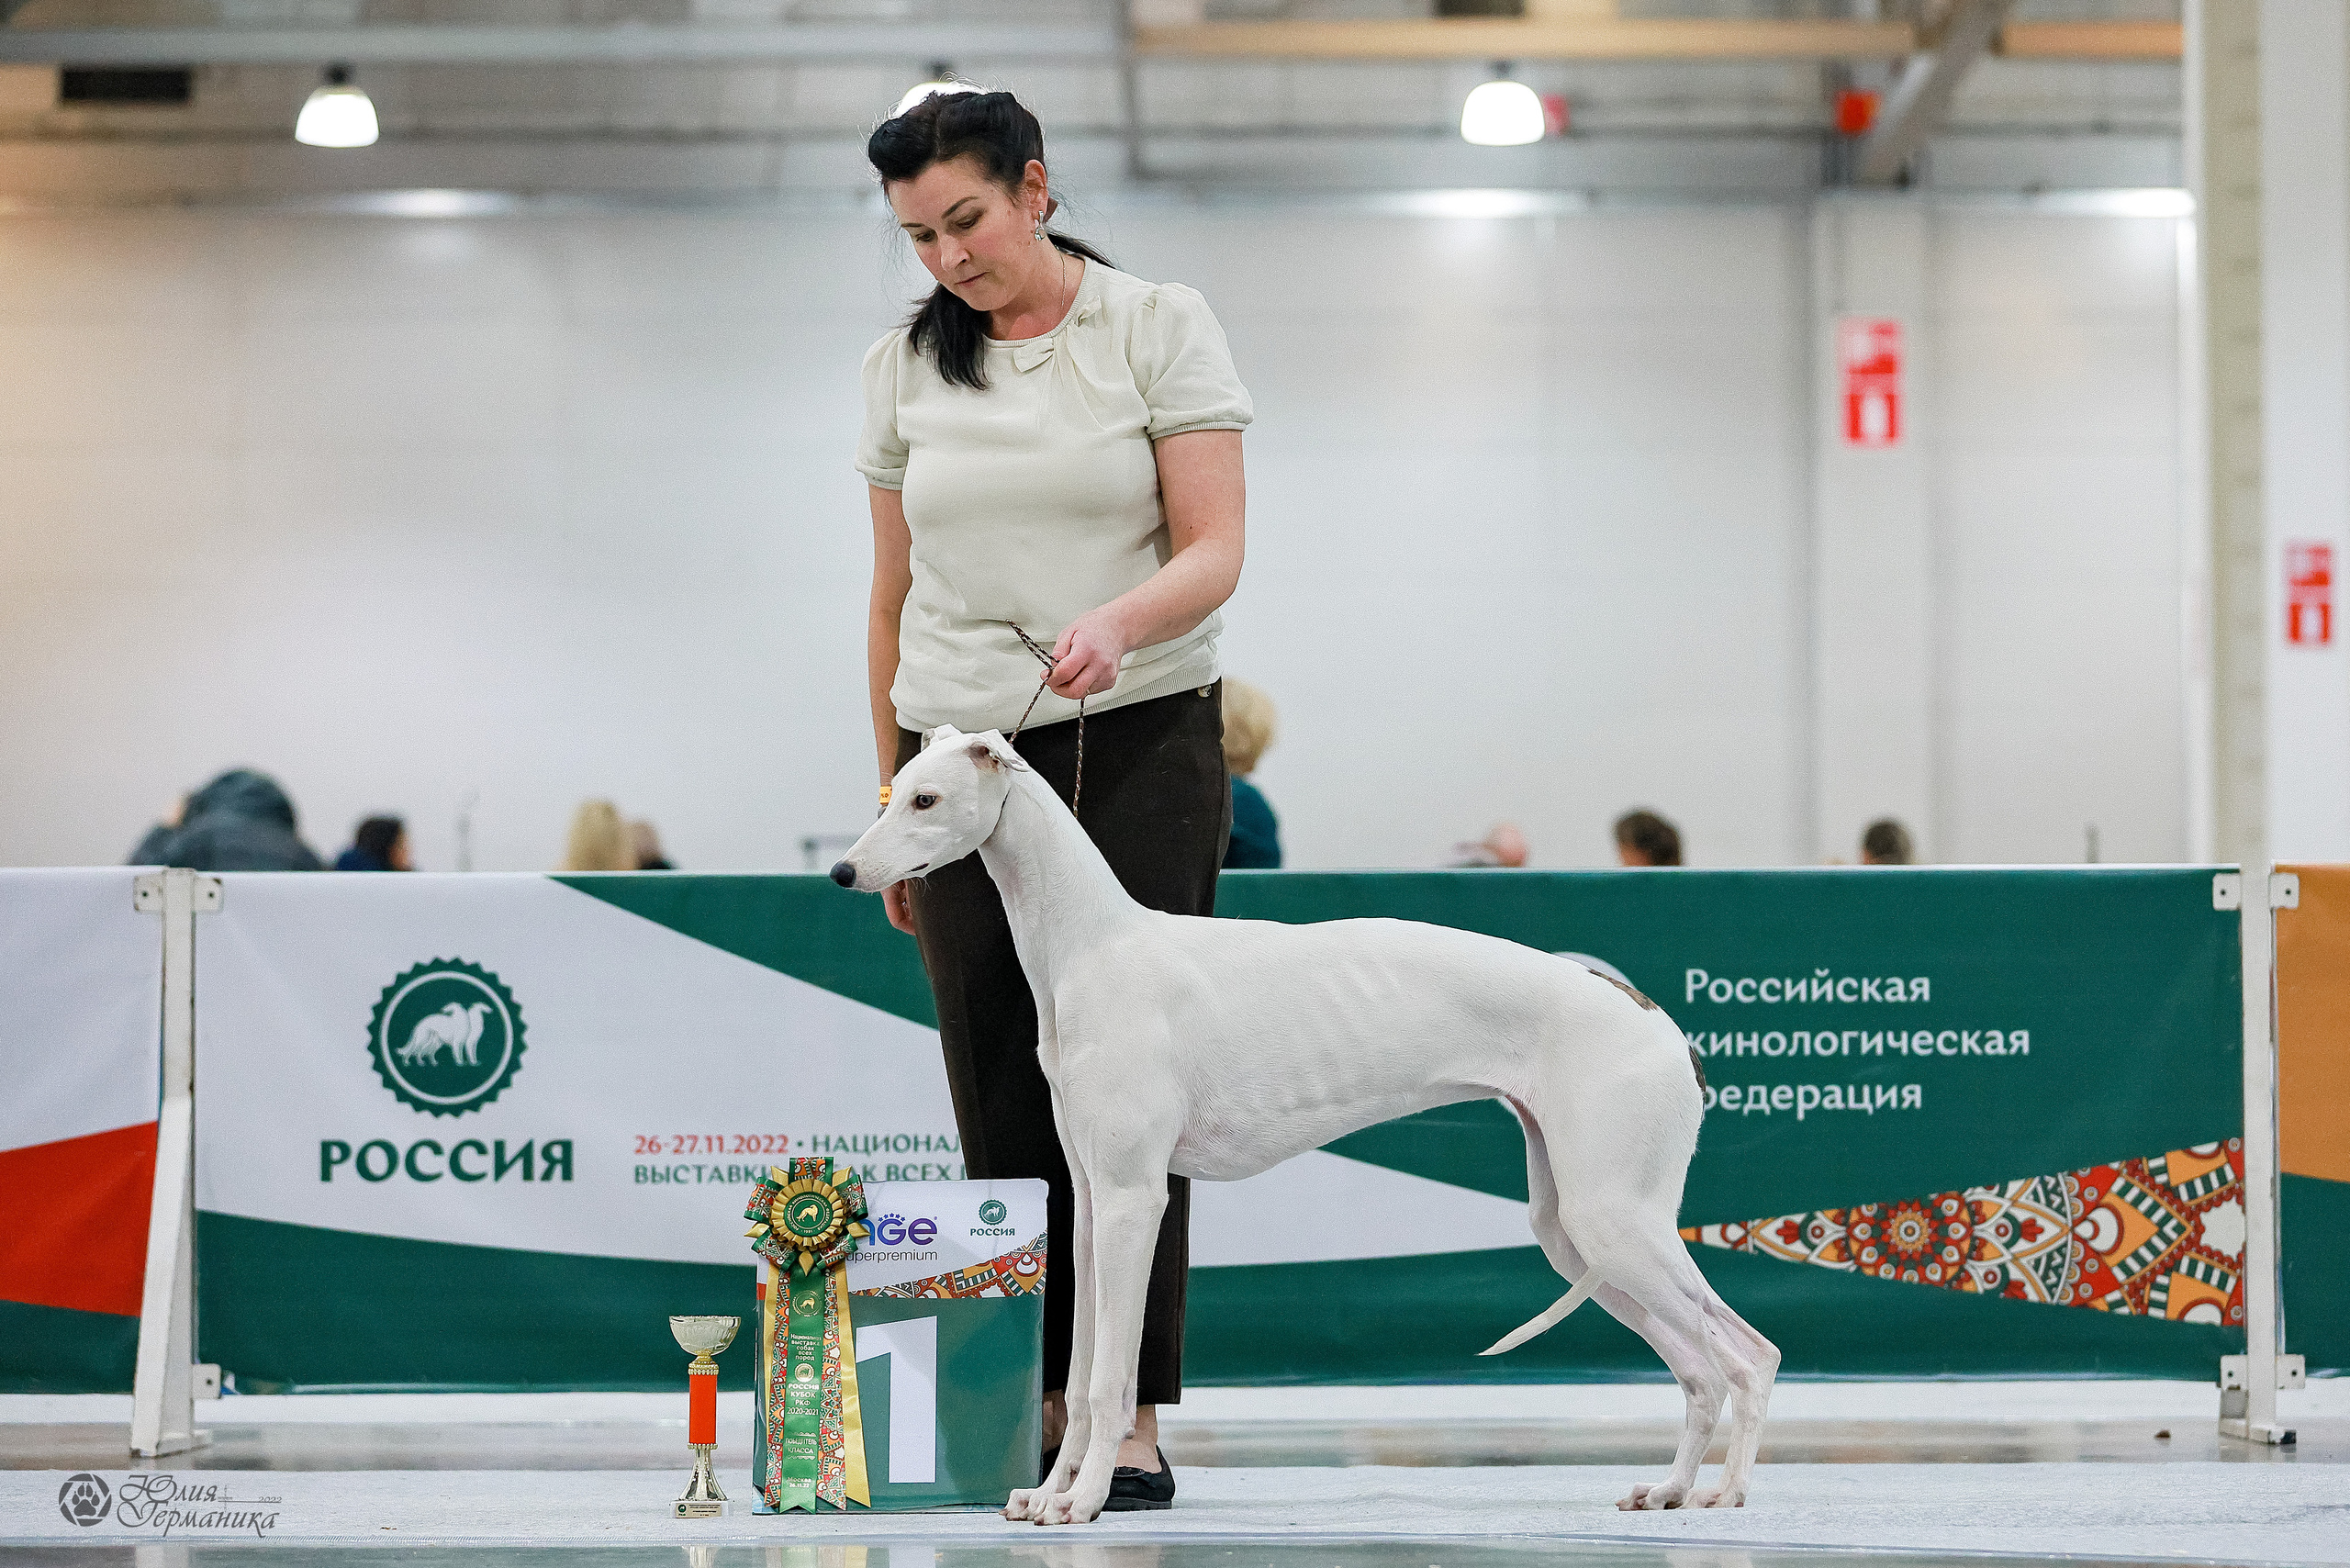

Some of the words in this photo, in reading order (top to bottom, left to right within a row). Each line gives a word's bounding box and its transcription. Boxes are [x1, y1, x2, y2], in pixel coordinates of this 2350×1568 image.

[1685, 968, 1930, 1002] Российская
[1685, 1029, 2030, 1057] кинологическая
[634, 1134, 789, 1155] 26-27.11.2022
[320, 1139, 574, 1182] РОССИЯ
[886, 1163, 952, 1182] ВСЕХ
[970, 1228, 1015, 1237] РОССИЯ
[846, 1249, 937, 1263] uperpremium
[856, 1316, 937, 1483] 1
[787, 1407, 819, 1416] 2020-2021
